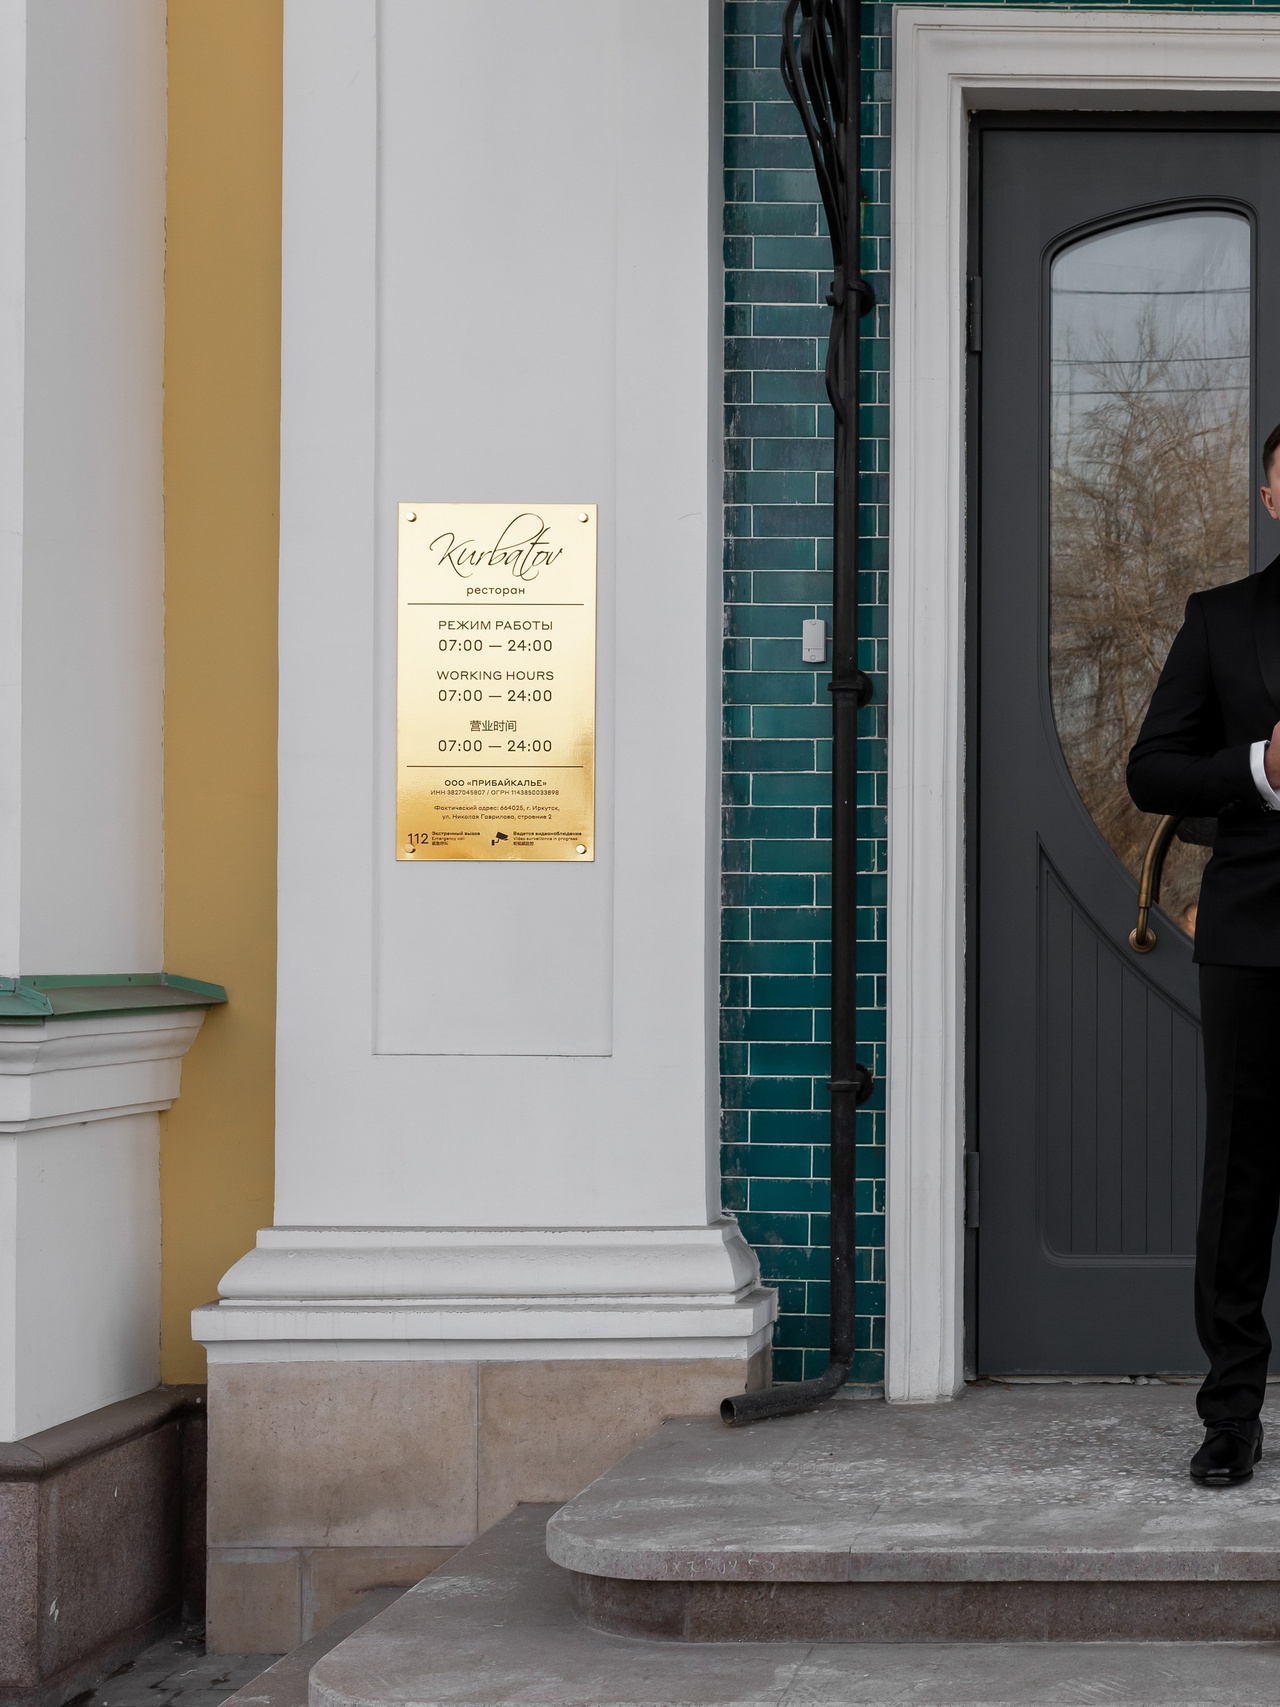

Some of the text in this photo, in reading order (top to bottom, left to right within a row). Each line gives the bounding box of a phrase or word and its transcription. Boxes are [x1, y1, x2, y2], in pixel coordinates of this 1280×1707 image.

[429, 513, 563, 581] Kurbatov
[466, 587, 525, 597] ресторан
[439, 620, 553, 630] РЕЖИМ РАБОТЫ
[439, 639, 483, 651] 07:00
[508, 639, 552, 652] 24:00
[436, 670, 554, 681] WORKING HOURS
[438, 689, 482, 702] 07:00
[507, 690, 552, 702] 24:00
[470, 720, 517, 732] 营业时间
[438, 740, 482, 752] 07:00
[507, 740, 552, 752] 24:00
[467, 778, 547, 787] «ПРИБАЙКАЛЬЕ»
[408, 833, 429, 844] 112
